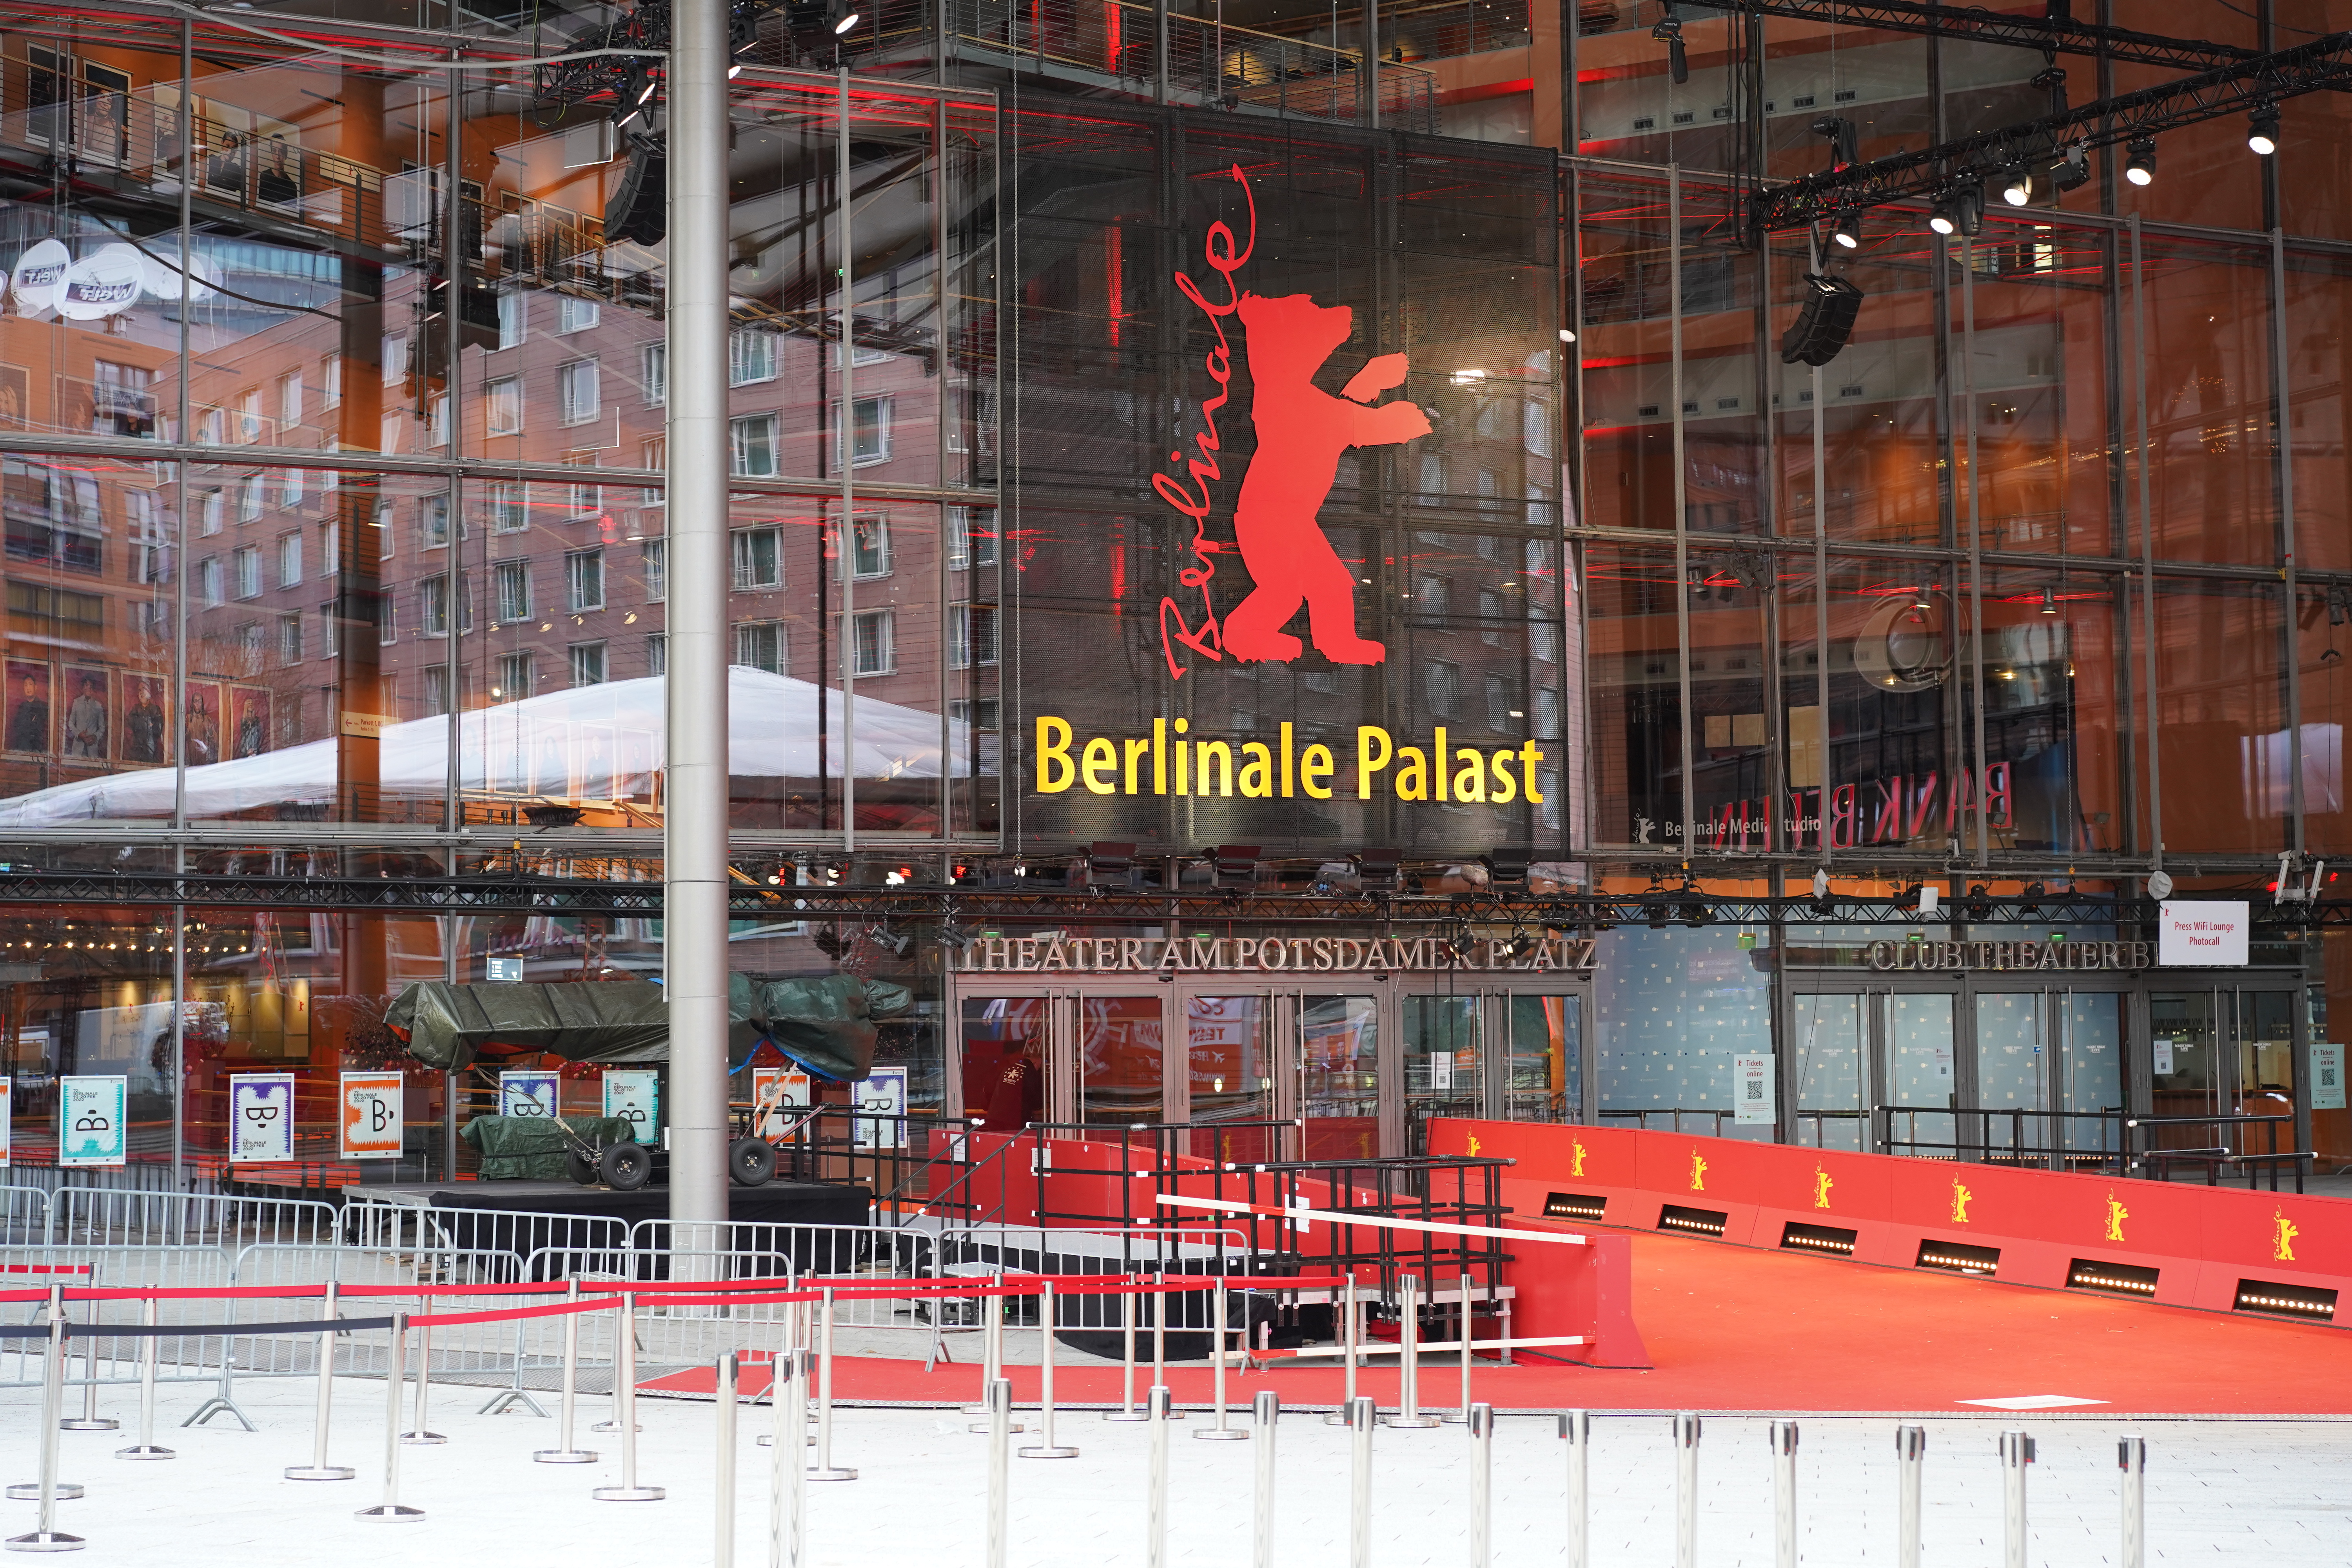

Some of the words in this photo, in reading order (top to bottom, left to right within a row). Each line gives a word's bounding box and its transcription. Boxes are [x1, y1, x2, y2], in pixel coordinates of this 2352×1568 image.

[1152, 163, 1255, 680] Berlinale
[1036, 716, 1333, 799] Berlinale
[1357, 726, 1544, 804] Palast
[1665, 819, 1726, 837] Beinale
[1784, 815, 1822, 832] tudio
[2175, 922, 2192, 931] Press
[2194, 922, 2208, 931] WiFi
[2210, 922, 2234, 933] Lounge
[2189, 936, 2220, 946] Photocall
[960, 937, 1149, 971] THEATER
[1157, 936, 1228, 971] AM
[1869, 940, 1962, 970] CLUB
[1972, 940, 2120, 971] THEATER
[2272, 1204, 2281, 1261] Berlinale
